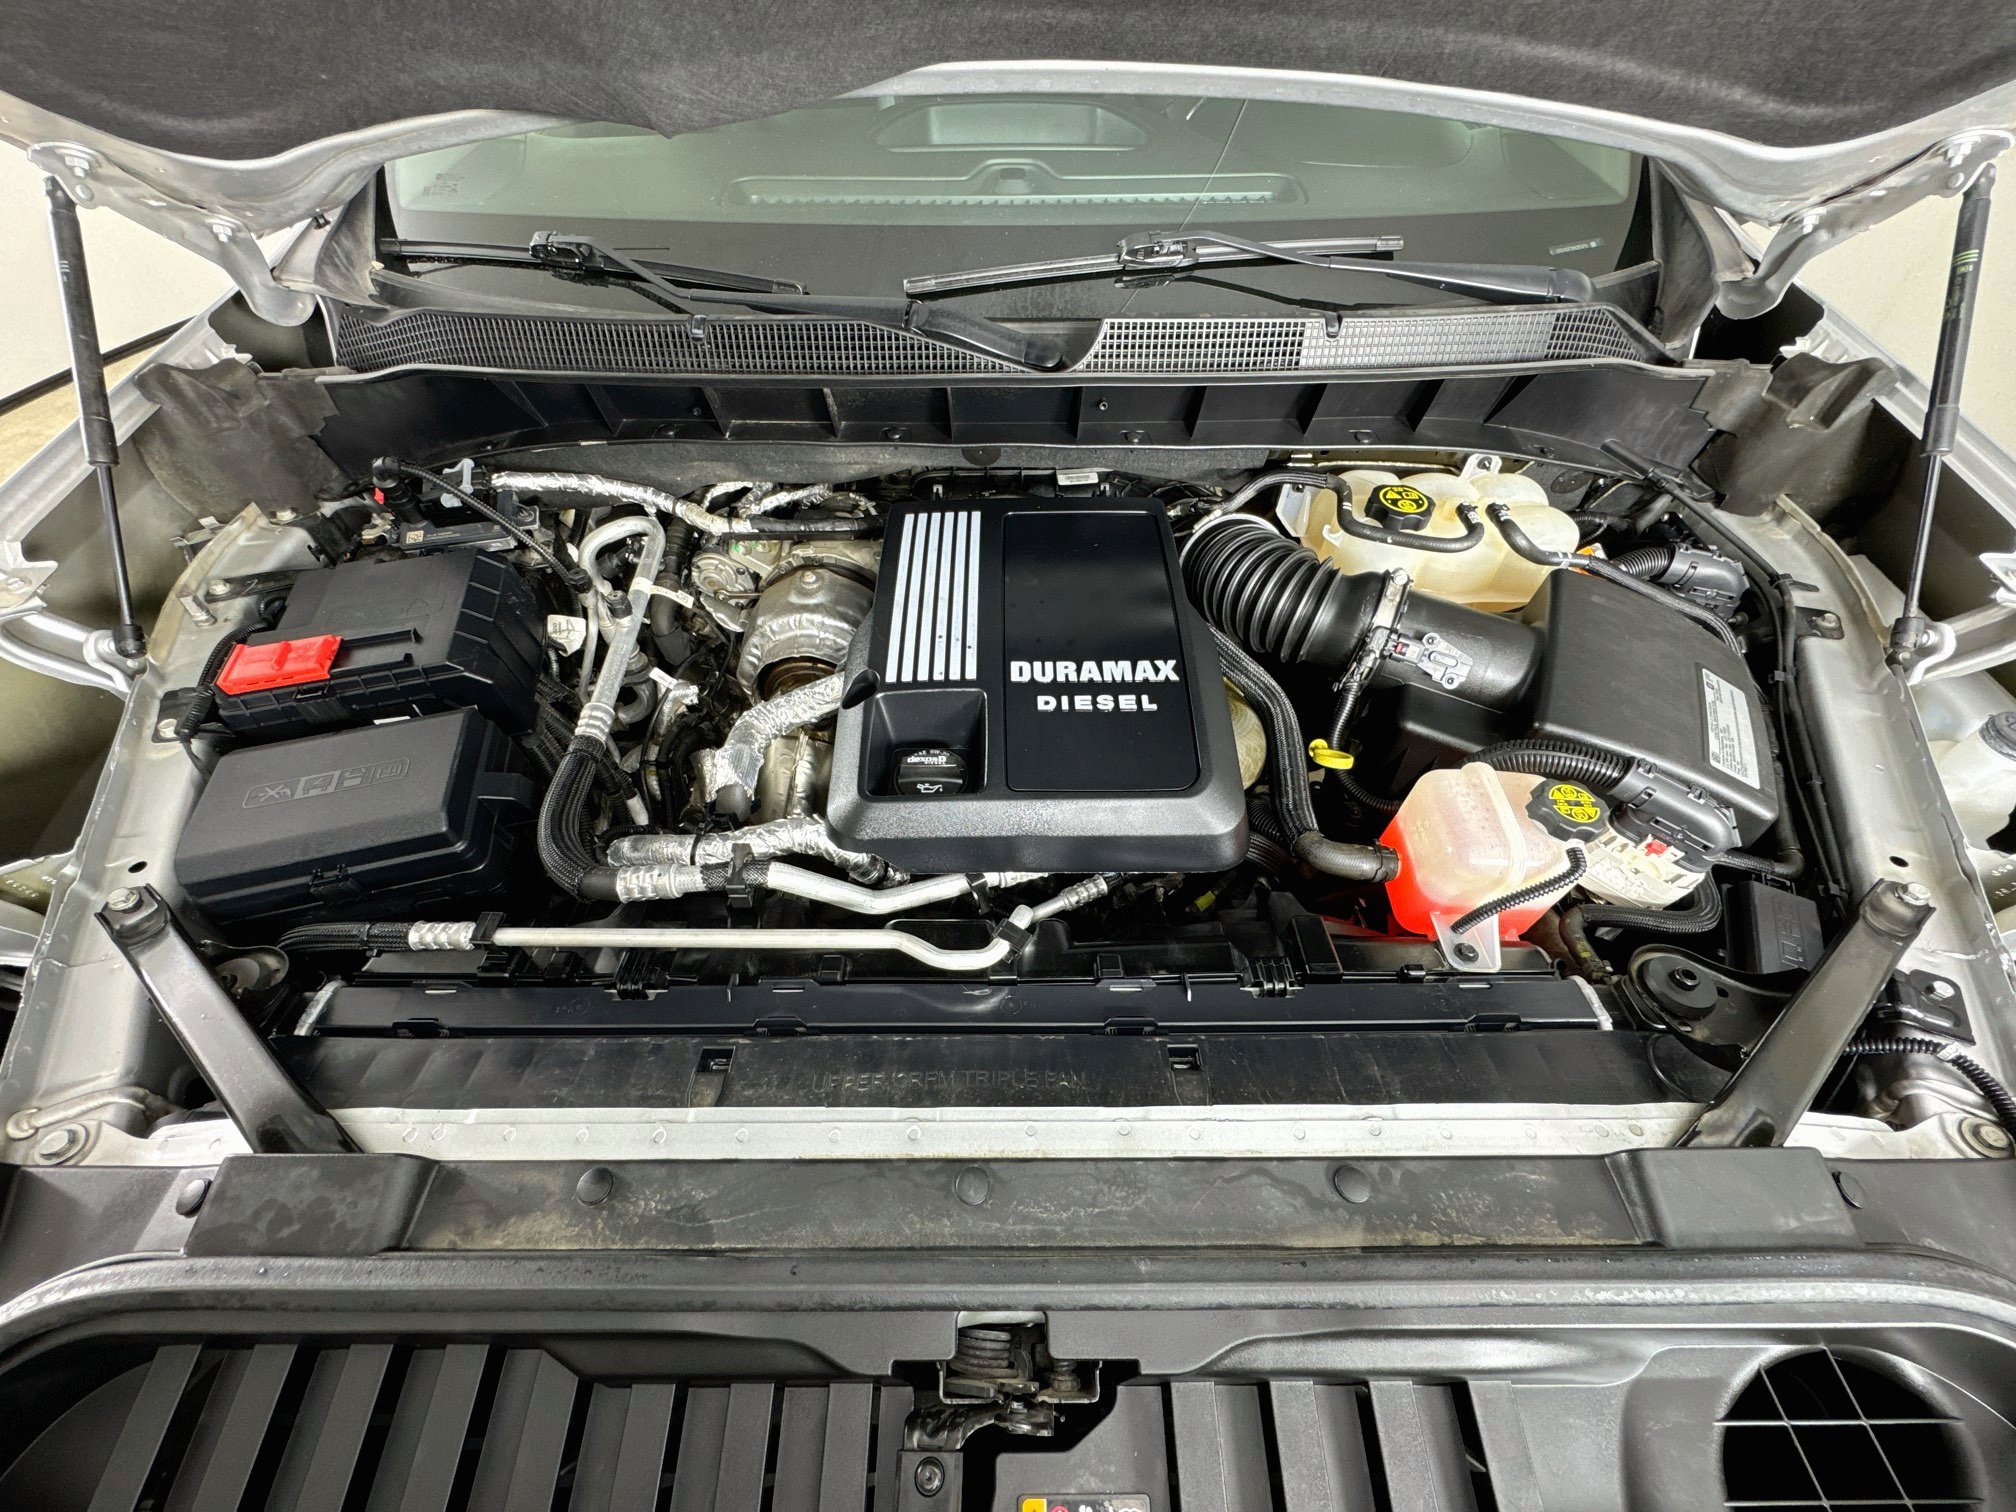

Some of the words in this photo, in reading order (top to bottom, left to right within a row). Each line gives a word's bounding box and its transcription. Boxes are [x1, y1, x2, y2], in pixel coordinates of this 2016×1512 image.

[1010, 660, 1180, 683] DURAMAX
[1037, 695, 1158, 712] DIESEL
[812, 1072, 885, 1092] UPPER
[962, 1069, 1038, 1089] TRIPLE
[1046, 1070, 1086, 1090] FAN
